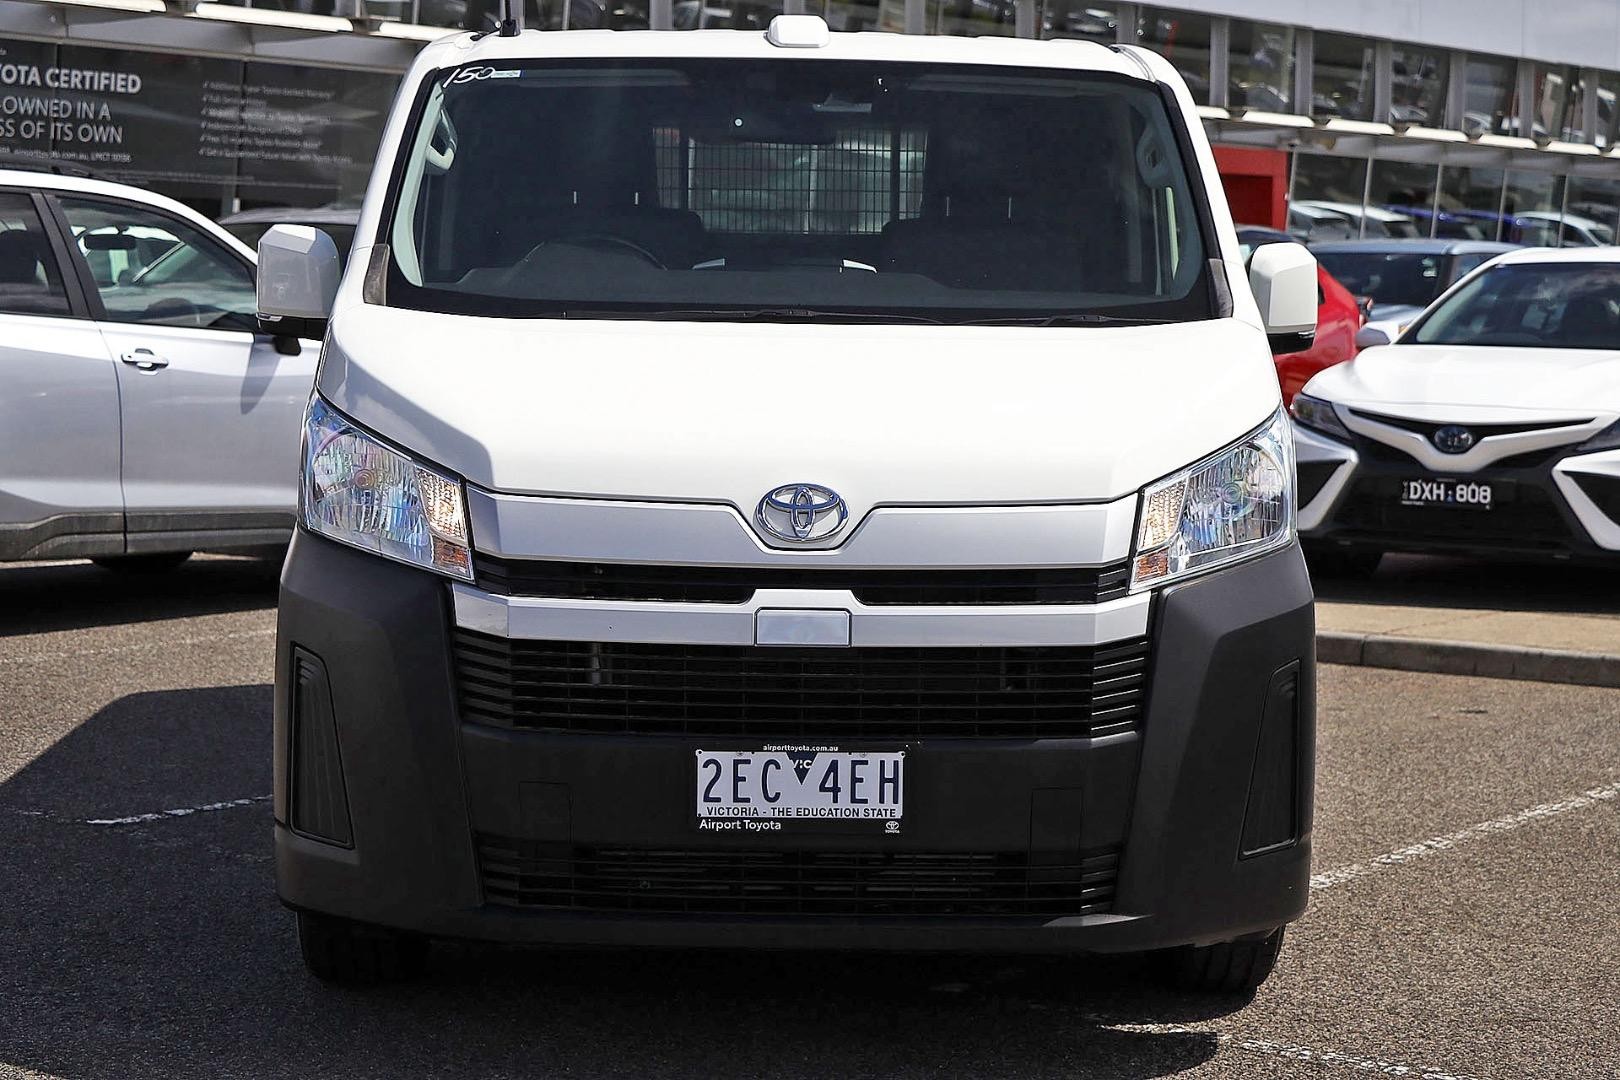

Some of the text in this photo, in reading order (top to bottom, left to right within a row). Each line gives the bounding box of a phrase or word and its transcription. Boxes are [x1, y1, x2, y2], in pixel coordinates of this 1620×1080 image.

[0, 64, 142, 94] OTA CERTIFIED
[442, 66, 495, 88] 150
[76, 101, 95, 120] IN
[99, 103, 112, 121] A
[20, 120, 46, 140] OF
[50, 121, 74, 142] ITS
[77, 122, 123, 144] OWN
[1409, 481, 1445, 501] DXH
[1456, 484, 1491, 504] 808
[763, 744, 839, 753] airporttoyota.com.au
[706, 806, 759, 817] VICTORIA
[770, 807, 793, 817] THE
[795, 807, 860, 818] EDUCATION
[863, 808, 896, 818] STATE
[699, 819, 782, 832] Airport Toyota
